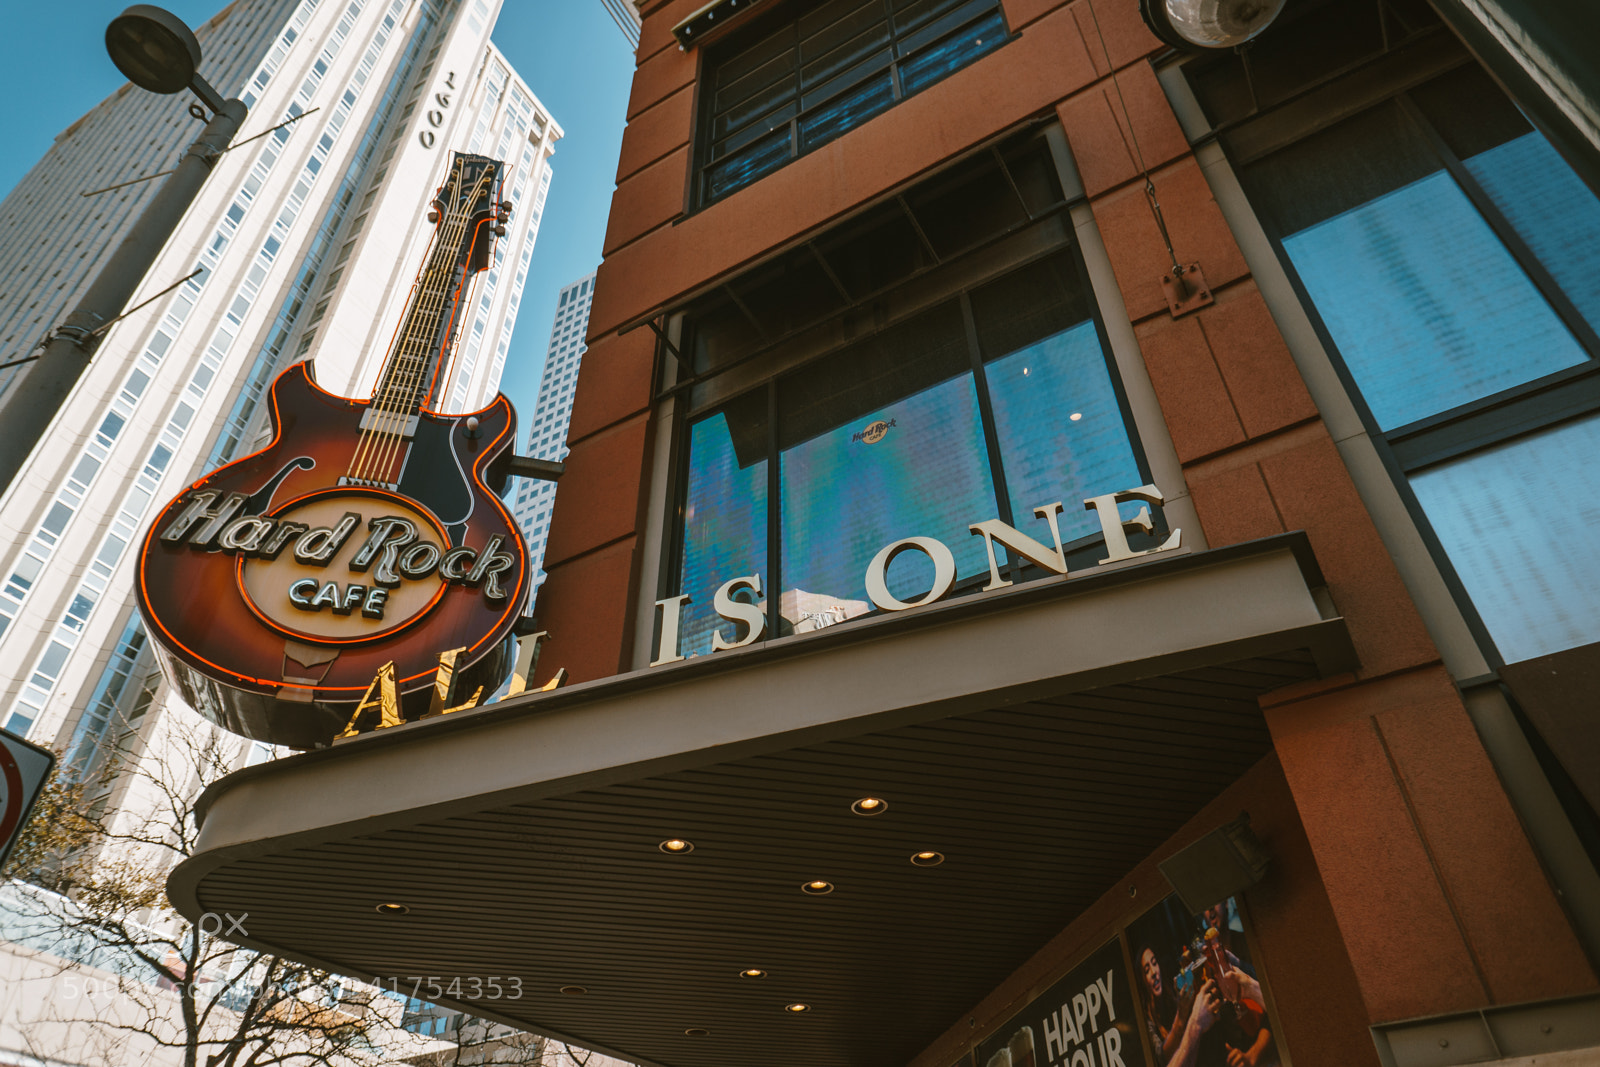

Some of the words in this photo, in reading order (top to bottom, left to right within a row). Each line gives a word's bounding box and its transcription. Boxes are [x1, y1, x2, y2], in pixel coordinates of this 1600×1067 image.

[160, 489, 362, 567] Hard
[348, 515, 515, 600] Rock
[288, 577, 390, 620] CAFE
[333, 631, 569, 741] ALL
[649, 573, 768, 668] IS
[864, 483, 1183, 612] ONE
[1042, 968, 1116, 1063] HAPPY
[1053, 1027, 1127, 1067] UR
